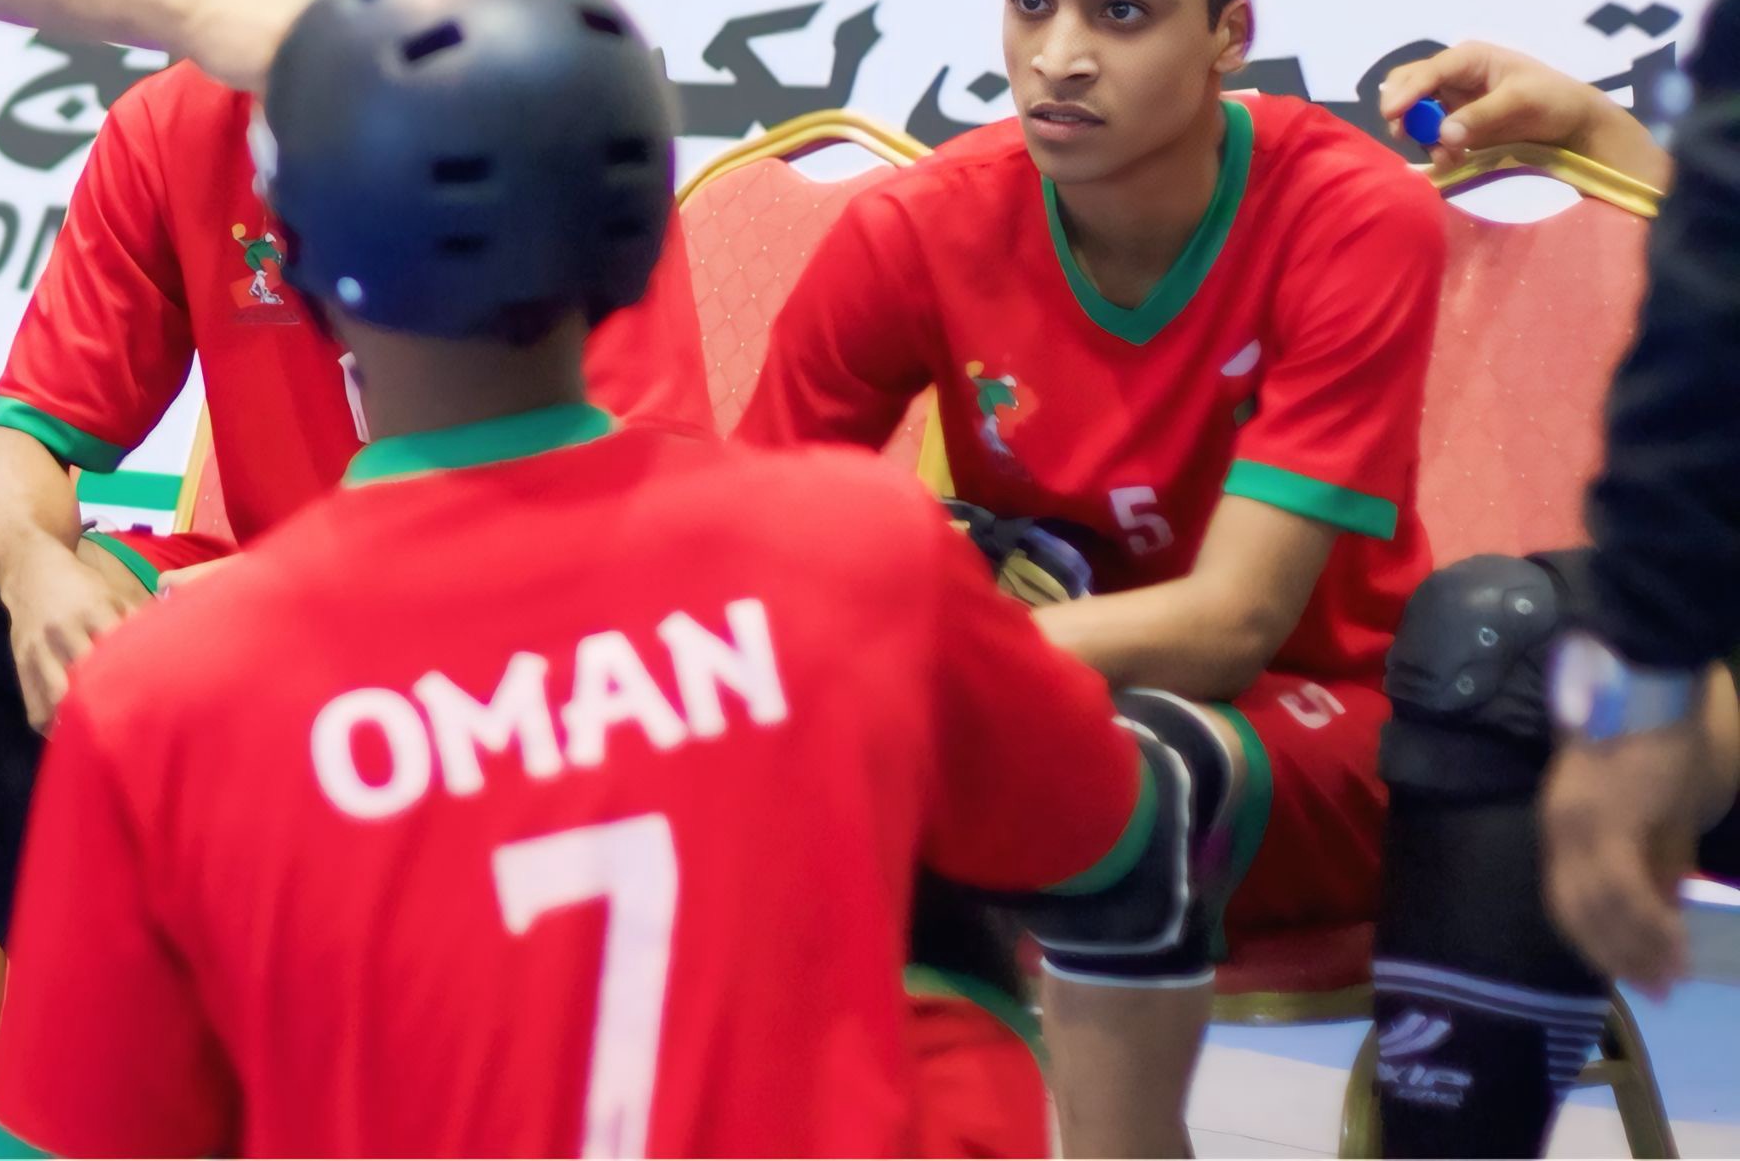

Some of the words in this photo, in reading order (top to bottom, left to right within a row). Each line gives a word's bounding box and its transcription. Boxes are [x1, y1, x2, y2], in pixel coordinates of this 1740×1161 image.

[1109, 486, 1175, 555] 5
[310, 597, 789, 821] OMAN
[491, 812, 679, 1159] 7
